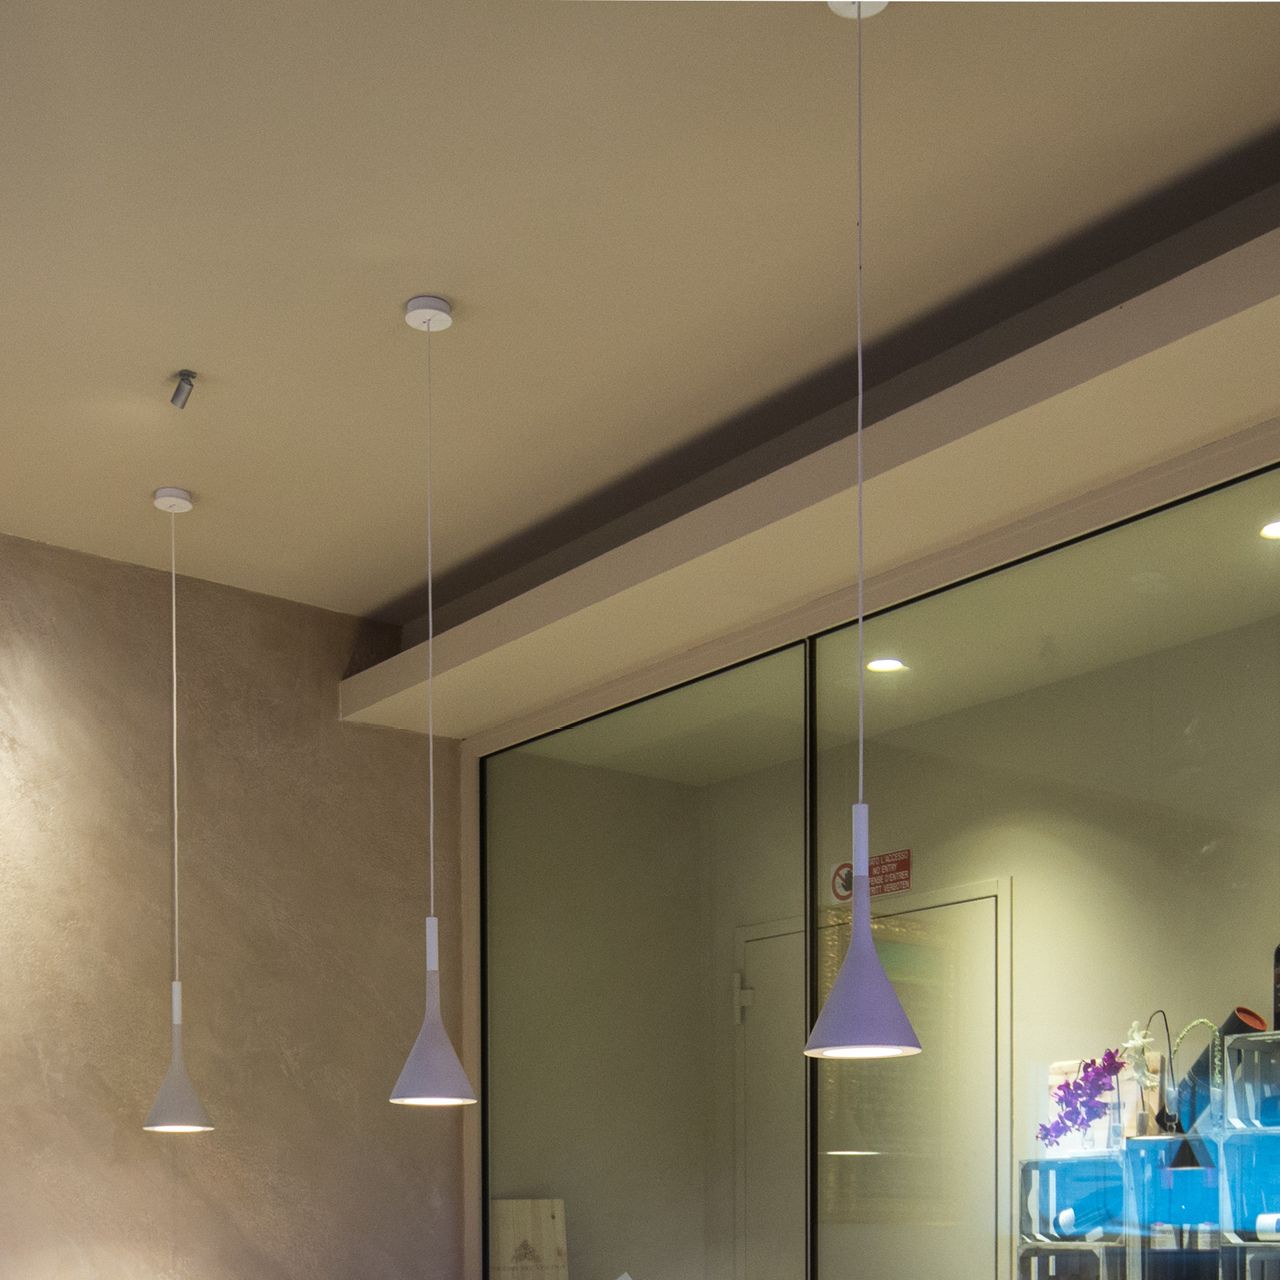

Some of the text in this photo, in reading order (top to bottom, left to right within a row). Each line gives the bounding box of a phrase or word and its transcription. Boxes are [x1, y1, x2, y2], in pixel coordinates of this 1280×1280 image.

[873, 864, 897, 875] NO ENTRY
[883, 881, 909, 892] VERBOTEN
